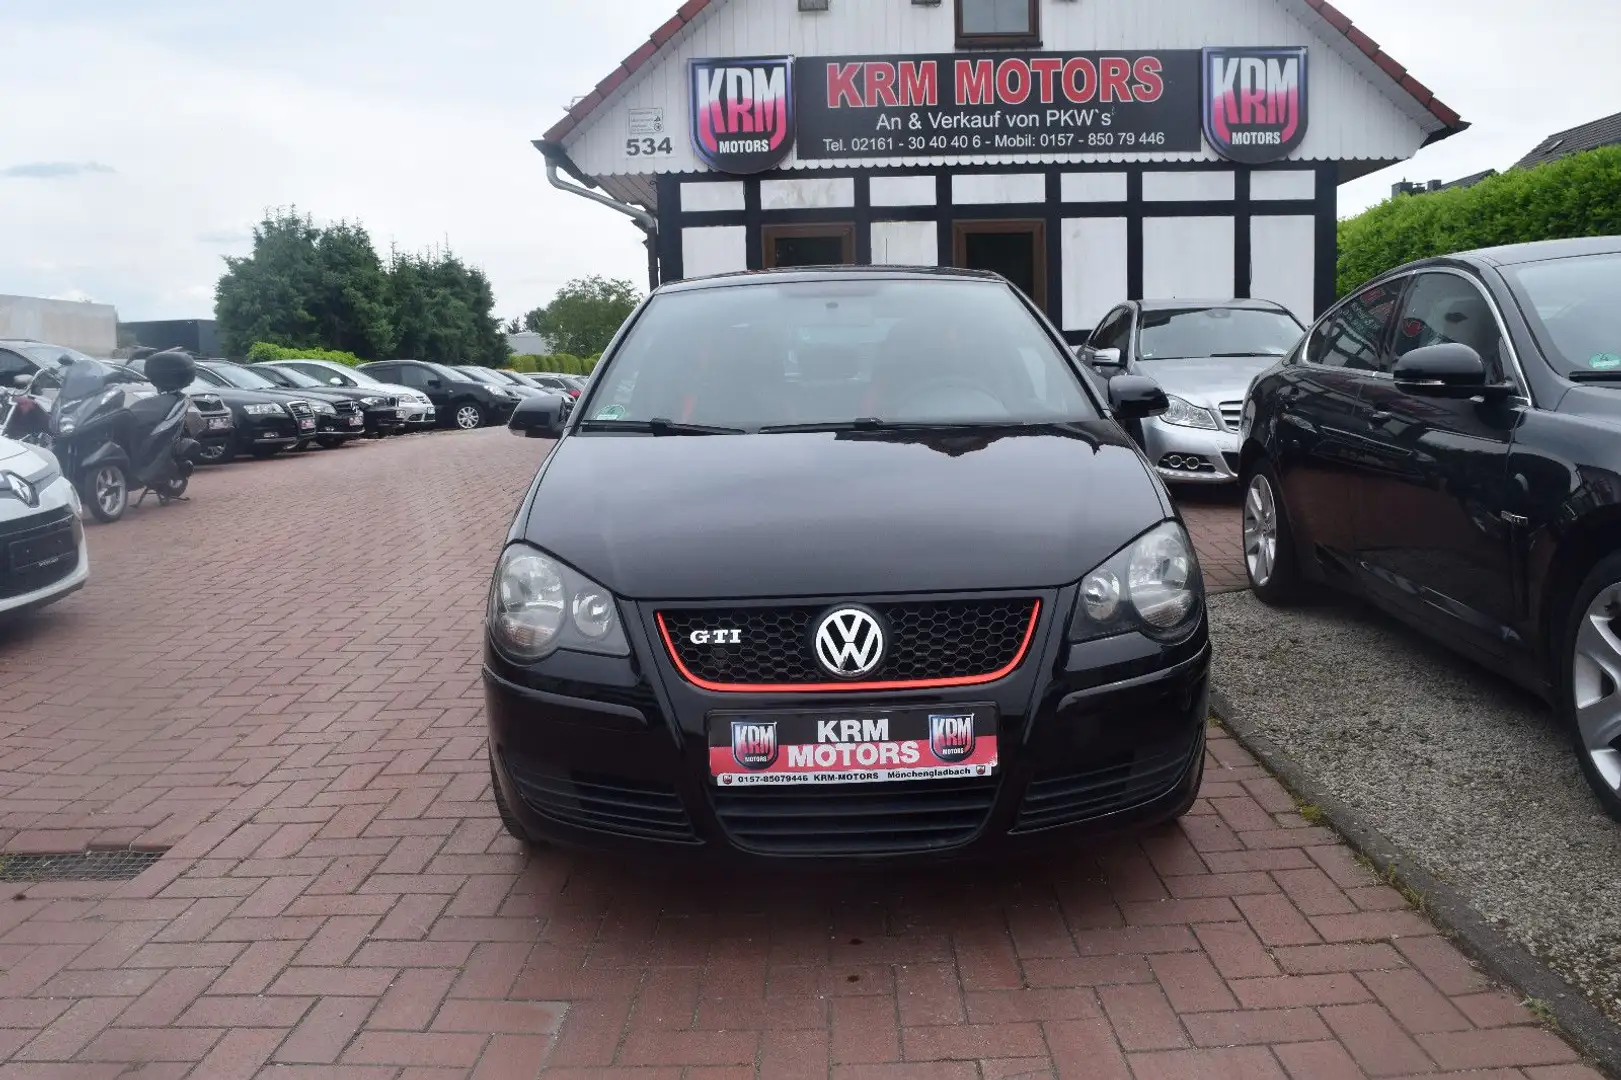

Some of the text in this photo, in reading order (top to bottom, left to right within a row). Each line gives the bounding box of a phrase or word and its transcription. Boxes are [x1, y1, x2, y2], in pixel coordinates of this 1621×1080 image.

[826, 56, 1164, 109] KRM MOTORS
[1212, 57, 1299, 125] KRM
[698, 67, 787, 133] KRM
[876, 113, 901, 131] An
[908, 112, 922, 130] &
[928, 110, 1001, 129] Verkauf
[1005, 113, 1040, 128] von
[626, 137, 673, 156] 534
[719, 139, 769, 154] MOTORS
[823, 138, 847, 151] Tel.
[851, 137, 893, 151] 02161
[908, 136, 926, 150] 30
[929, 135, 947, 149] 40
[950, 135, 968, 148] 40
[972, 135, 981, 148] 6
[995, 134, 1036, 147] Mobil:
[1040, 133, 1074, 146] 0157
[1088, 133, 1114, 146] 850
[1118, 132, 1135, 145] 79
[1139, 132, 1165, 145] 446
[1231, 131, 1281, 145] MOTORS
[689, 628, 742, 645] GTI
[735, 725, 775, 755] KRM
[817, 719, 889, 743] KRM
[932, 717, 973, 746] KRM
[744, 755, 767, 763] MOTORS
[788, 740, 920, 768] MOTORS
[942, 747, 964, 755] MOTORS
[737, 774, 808, 783] 0157-85079446
[813, 772, 879, 782] KRM-MOTORS
[887, 767, 971, 780] Mönchengladbach
